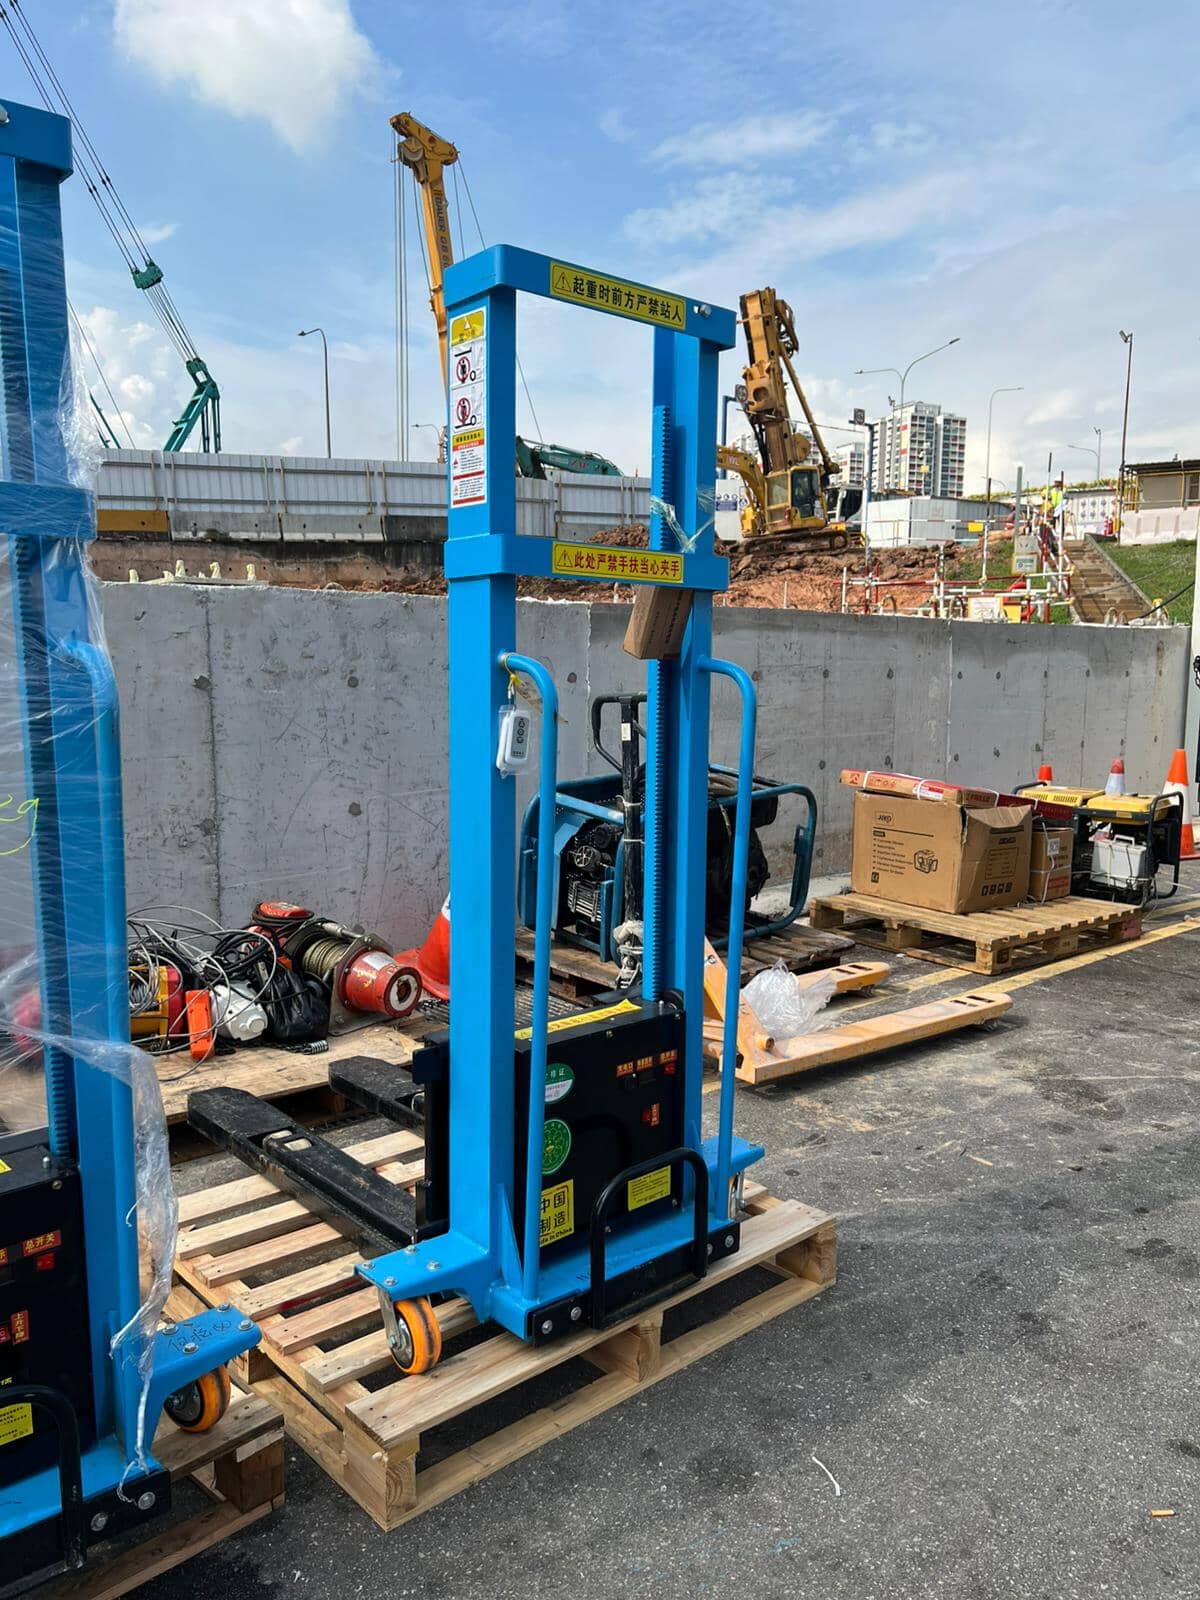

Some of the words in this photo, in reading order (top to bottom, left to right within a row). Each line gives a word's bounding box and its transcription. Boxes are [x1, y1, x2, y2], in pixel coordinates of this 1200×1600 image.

[573, 275, 682, 322] 起重时前方严禁站人
[574, 551, 680, 577] 此处严禁手扶当心夹手
